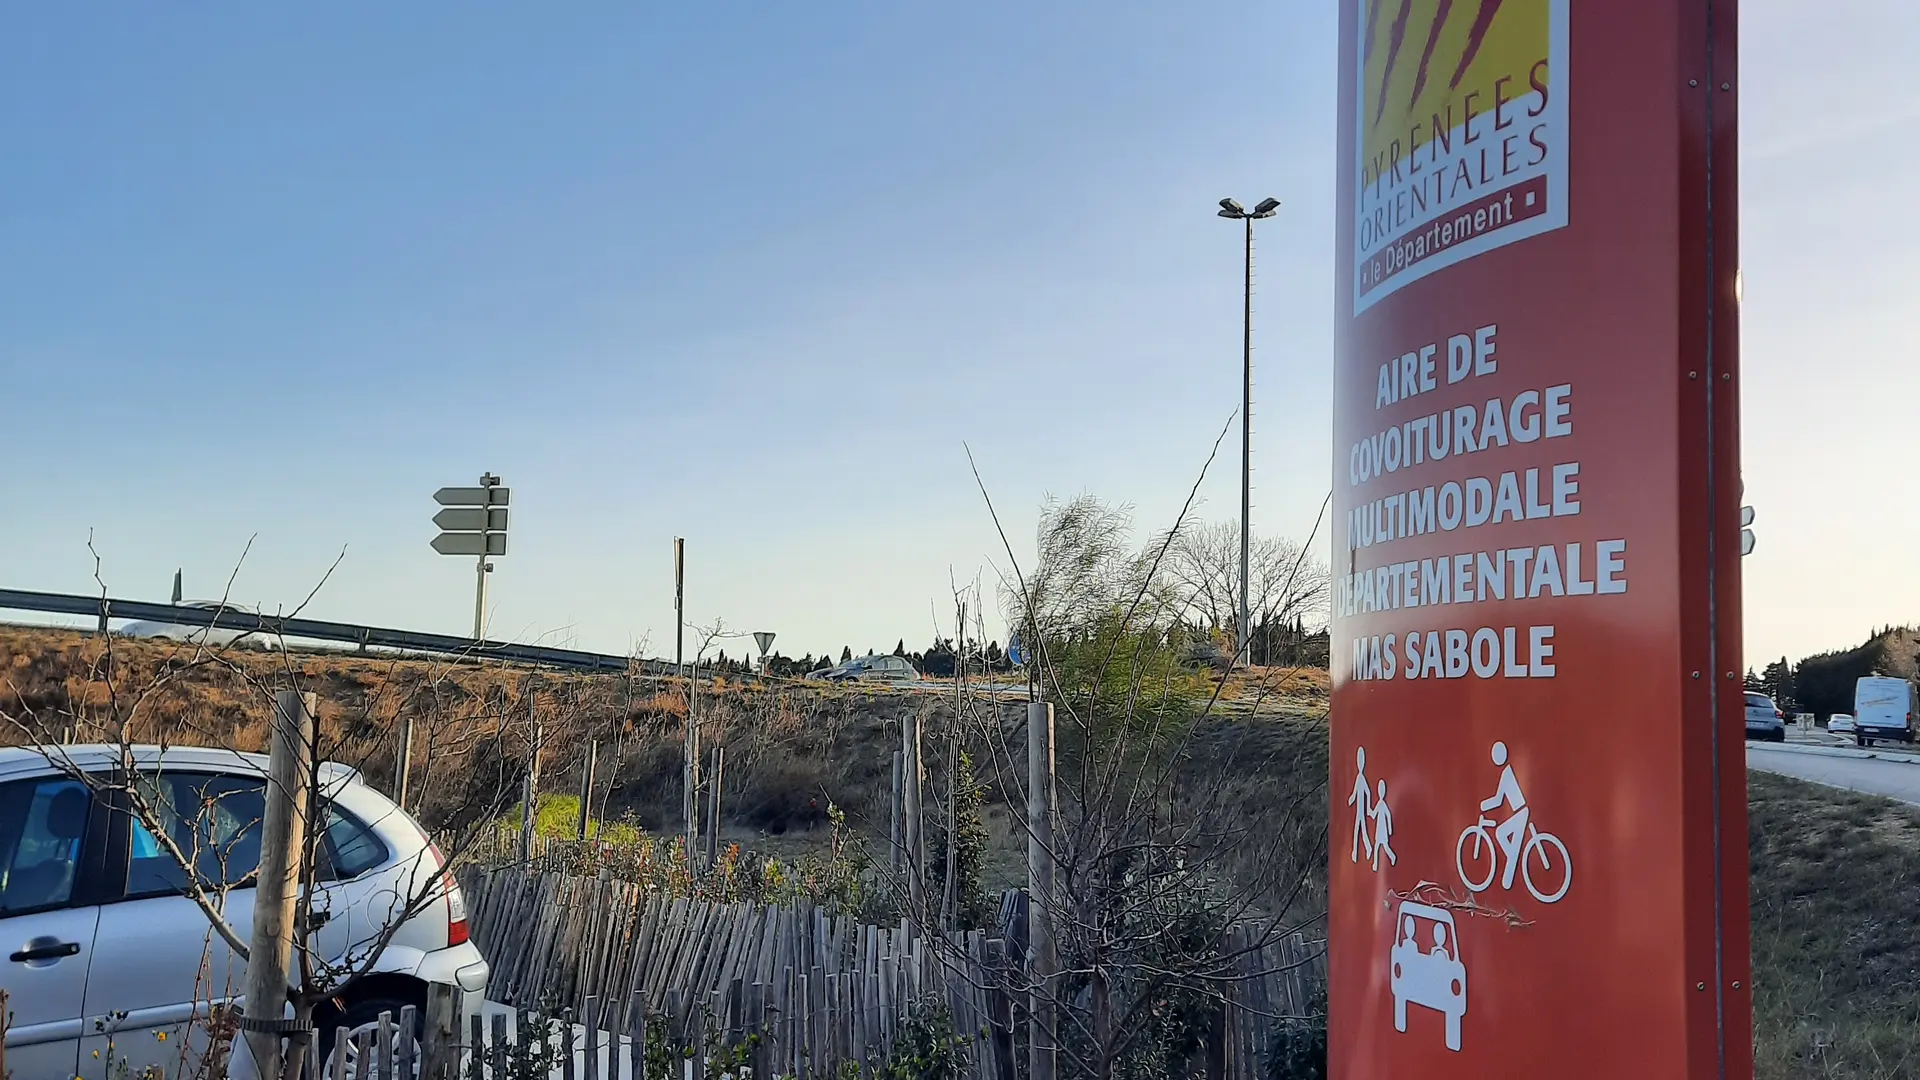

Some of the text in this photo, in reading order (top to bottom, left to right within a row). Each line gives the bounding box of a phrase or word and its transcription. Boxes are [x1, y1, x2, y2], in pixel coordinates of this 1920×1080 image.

[1360, 58, 1549, 214] PYRENEES
[1360, 123, 1548, 252] ORIENTALES
[1370, 192, 1513, 285] le Département
[1376, 324, 1497, 410] AIRE DE
[1350, 383, 1573, 487] COVOITURAGE
[1347, 461, 1580, 551] MULTIMODALE
[1337, 539, 1627, 619] DÉPARTEMENTALE
[1352, 625, 1556, 681] MAS SABOLE
